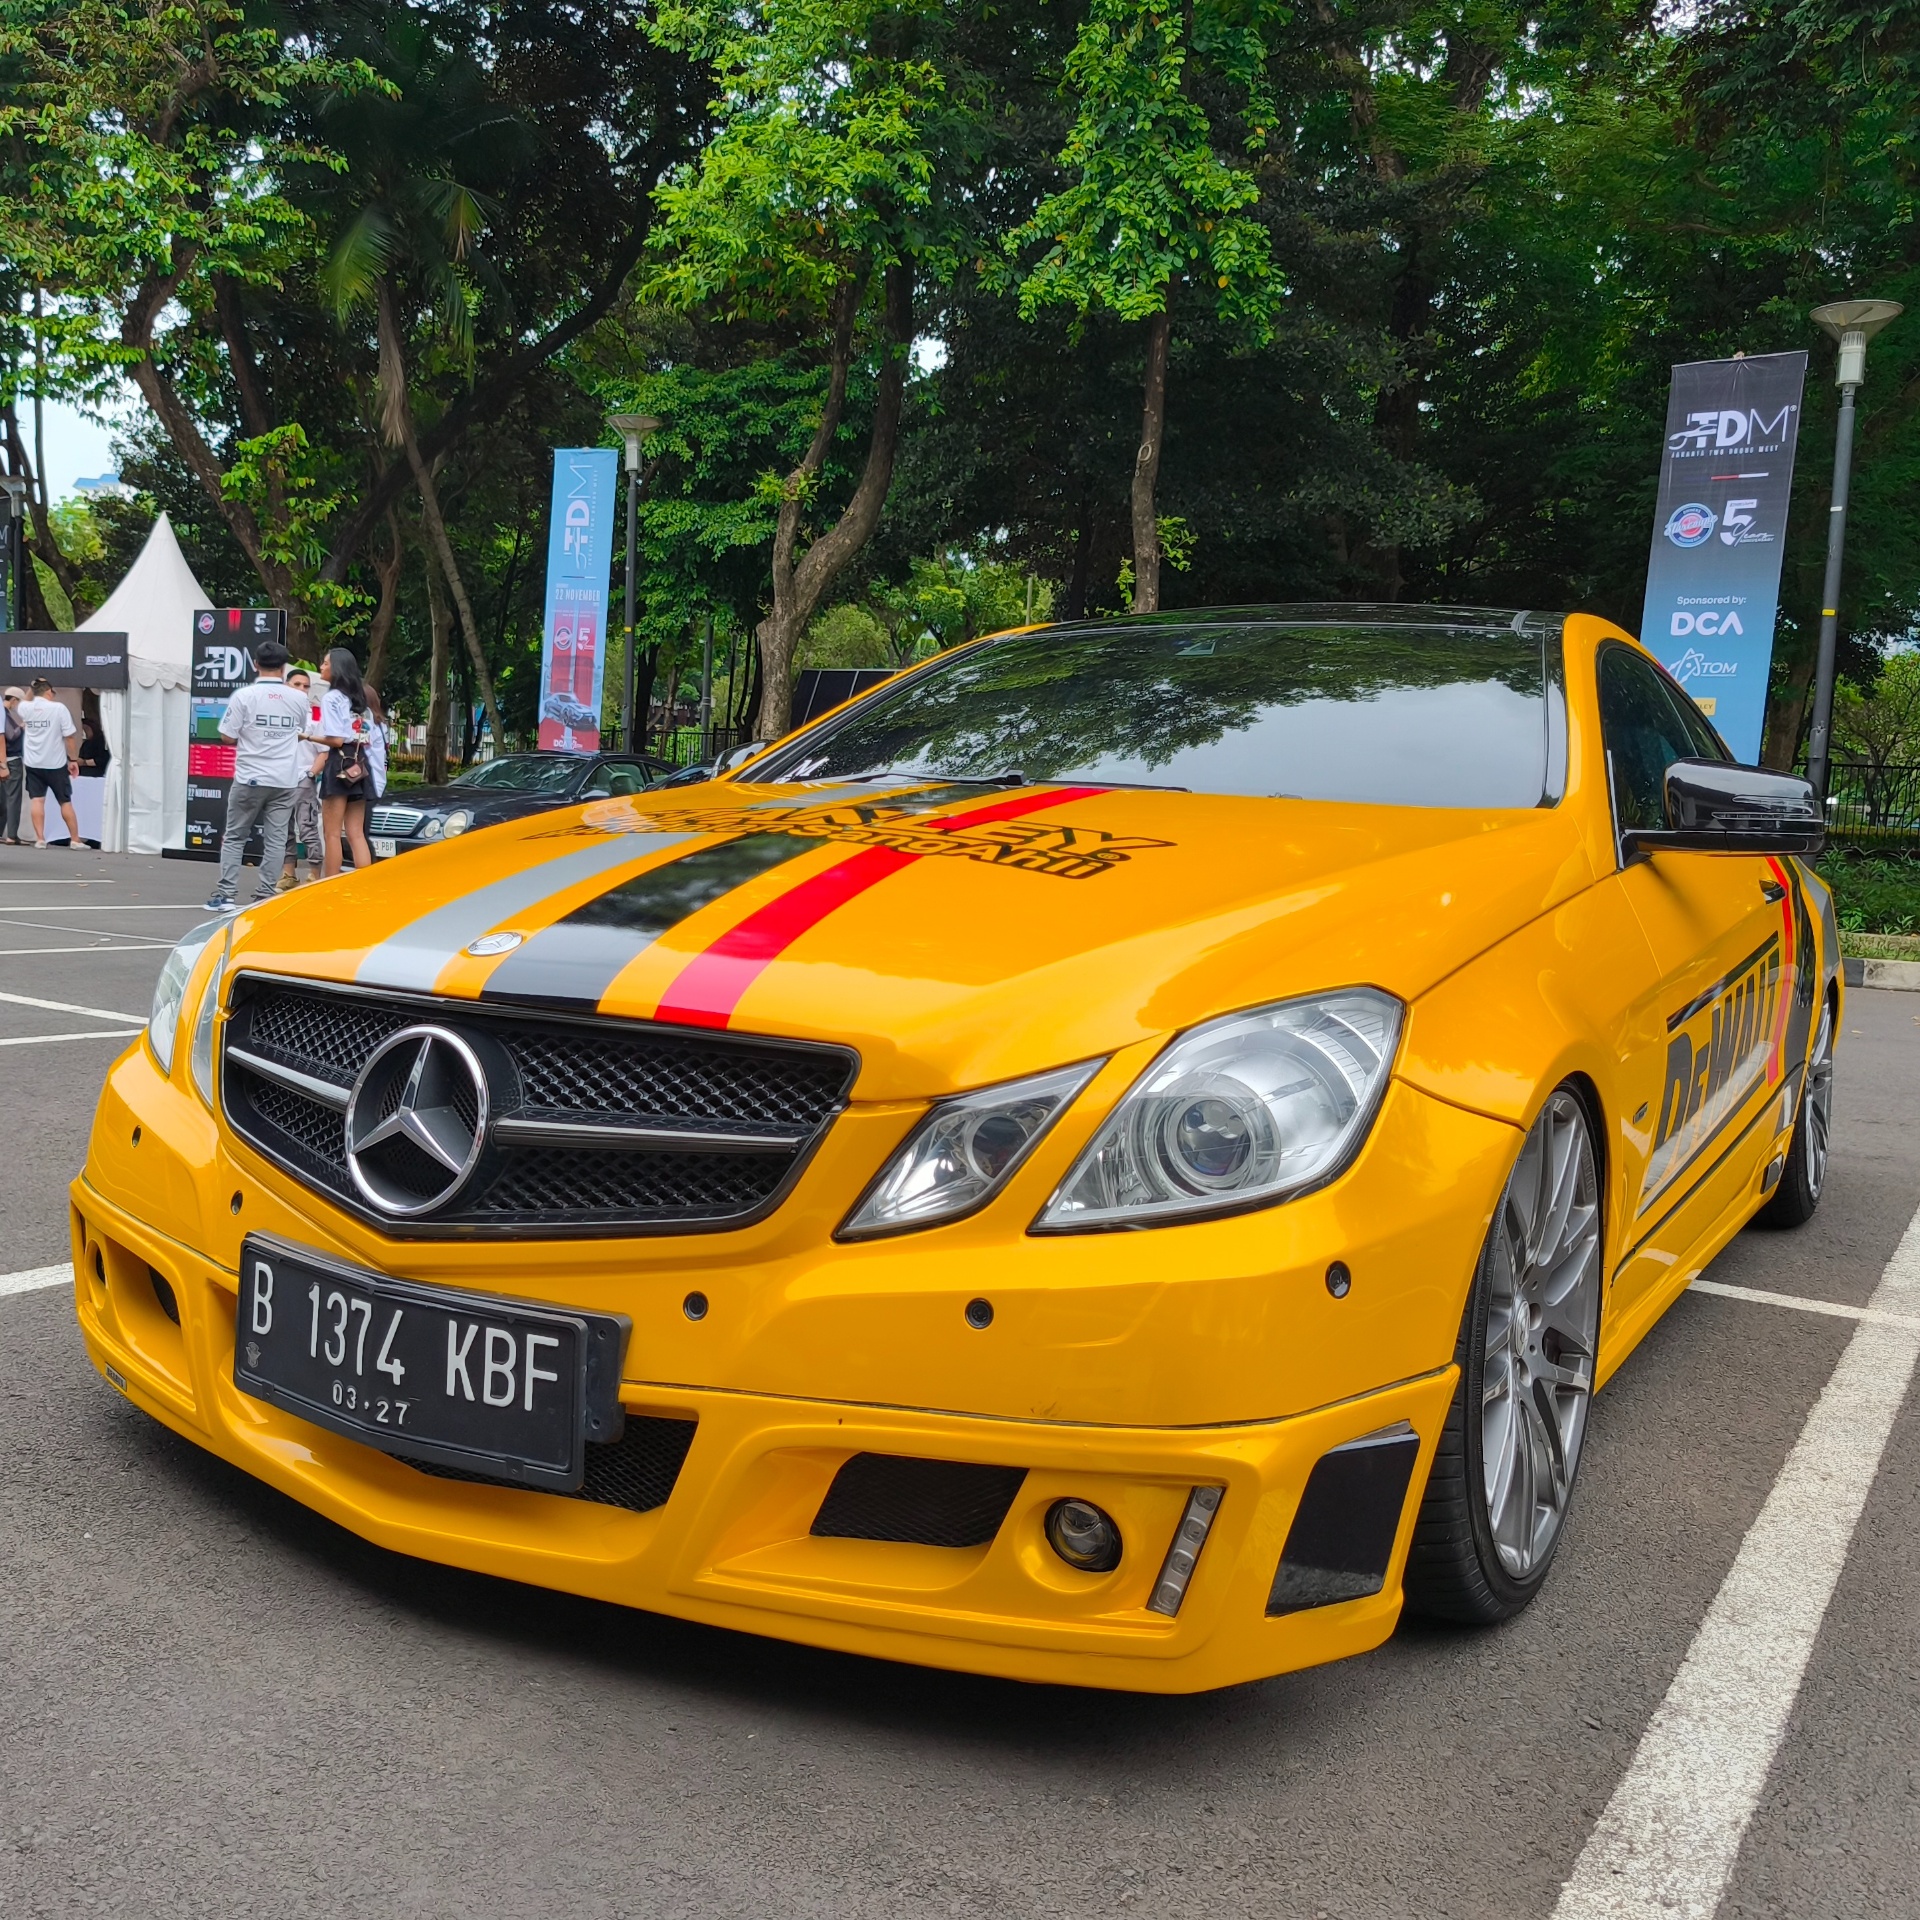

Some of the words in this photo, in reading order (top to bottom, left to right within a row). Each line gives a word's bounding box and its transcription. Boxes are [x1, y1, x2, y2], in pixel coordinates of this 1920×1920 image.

[555, 588, 564, 600] 22
[565, 589, 601, 601] NOVEMBER
[1676, 596, 1731, 606] Sponsored
[1732, 595, 1747, 606] by:
[1670, 611, 1744, 636] DCA
[10, 646, 73, 668] REGISTRATION
[251, 1261, 274, 1335] B
[308, 1282, 405, 1386] 1374
[446, 1319, 560, 1412] KBF
